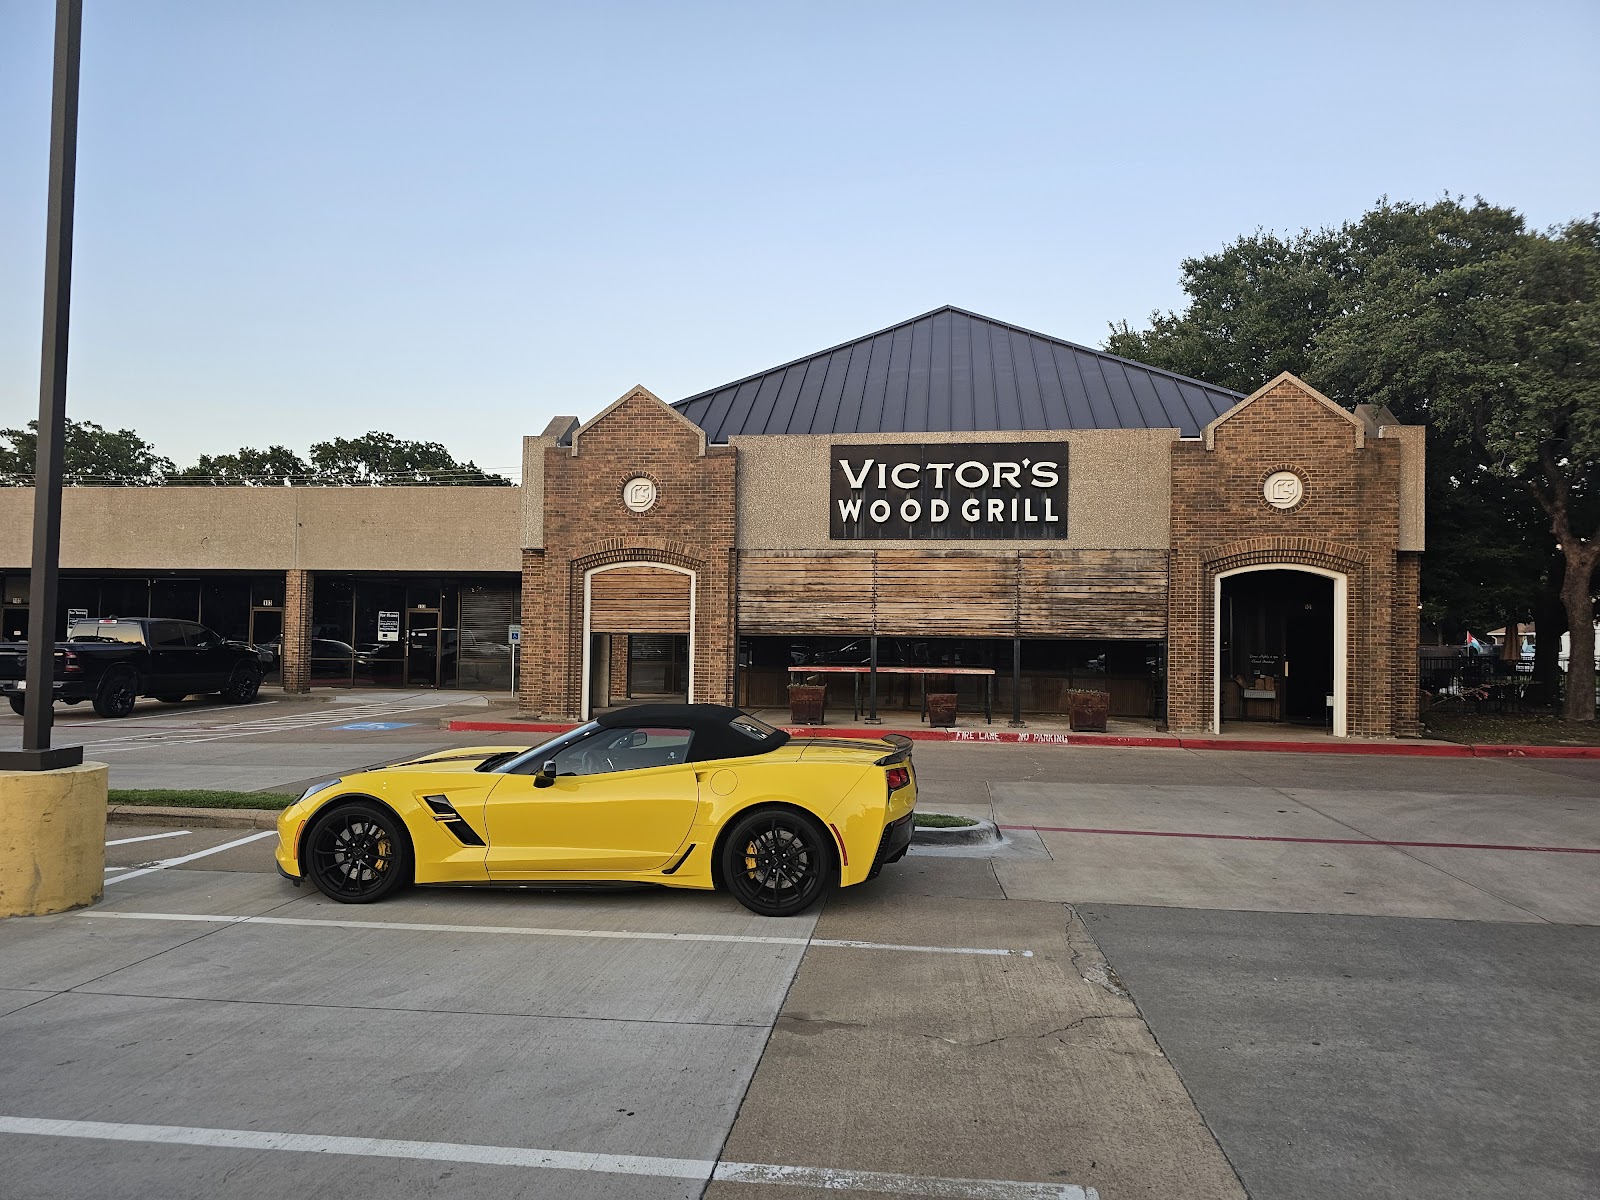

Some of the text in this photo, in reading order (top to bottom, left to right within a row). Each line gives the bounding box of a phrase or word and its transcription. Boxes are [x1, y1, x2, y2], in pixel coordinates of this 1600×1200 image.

[838, 457, 1059, 490] VICTOR'S
[838, 498, 1059, 523] WOOD GRILL
[956, 731, 1000, 741] FIRE LANE
[1018, 732, 1069, 744] NO PARKING
